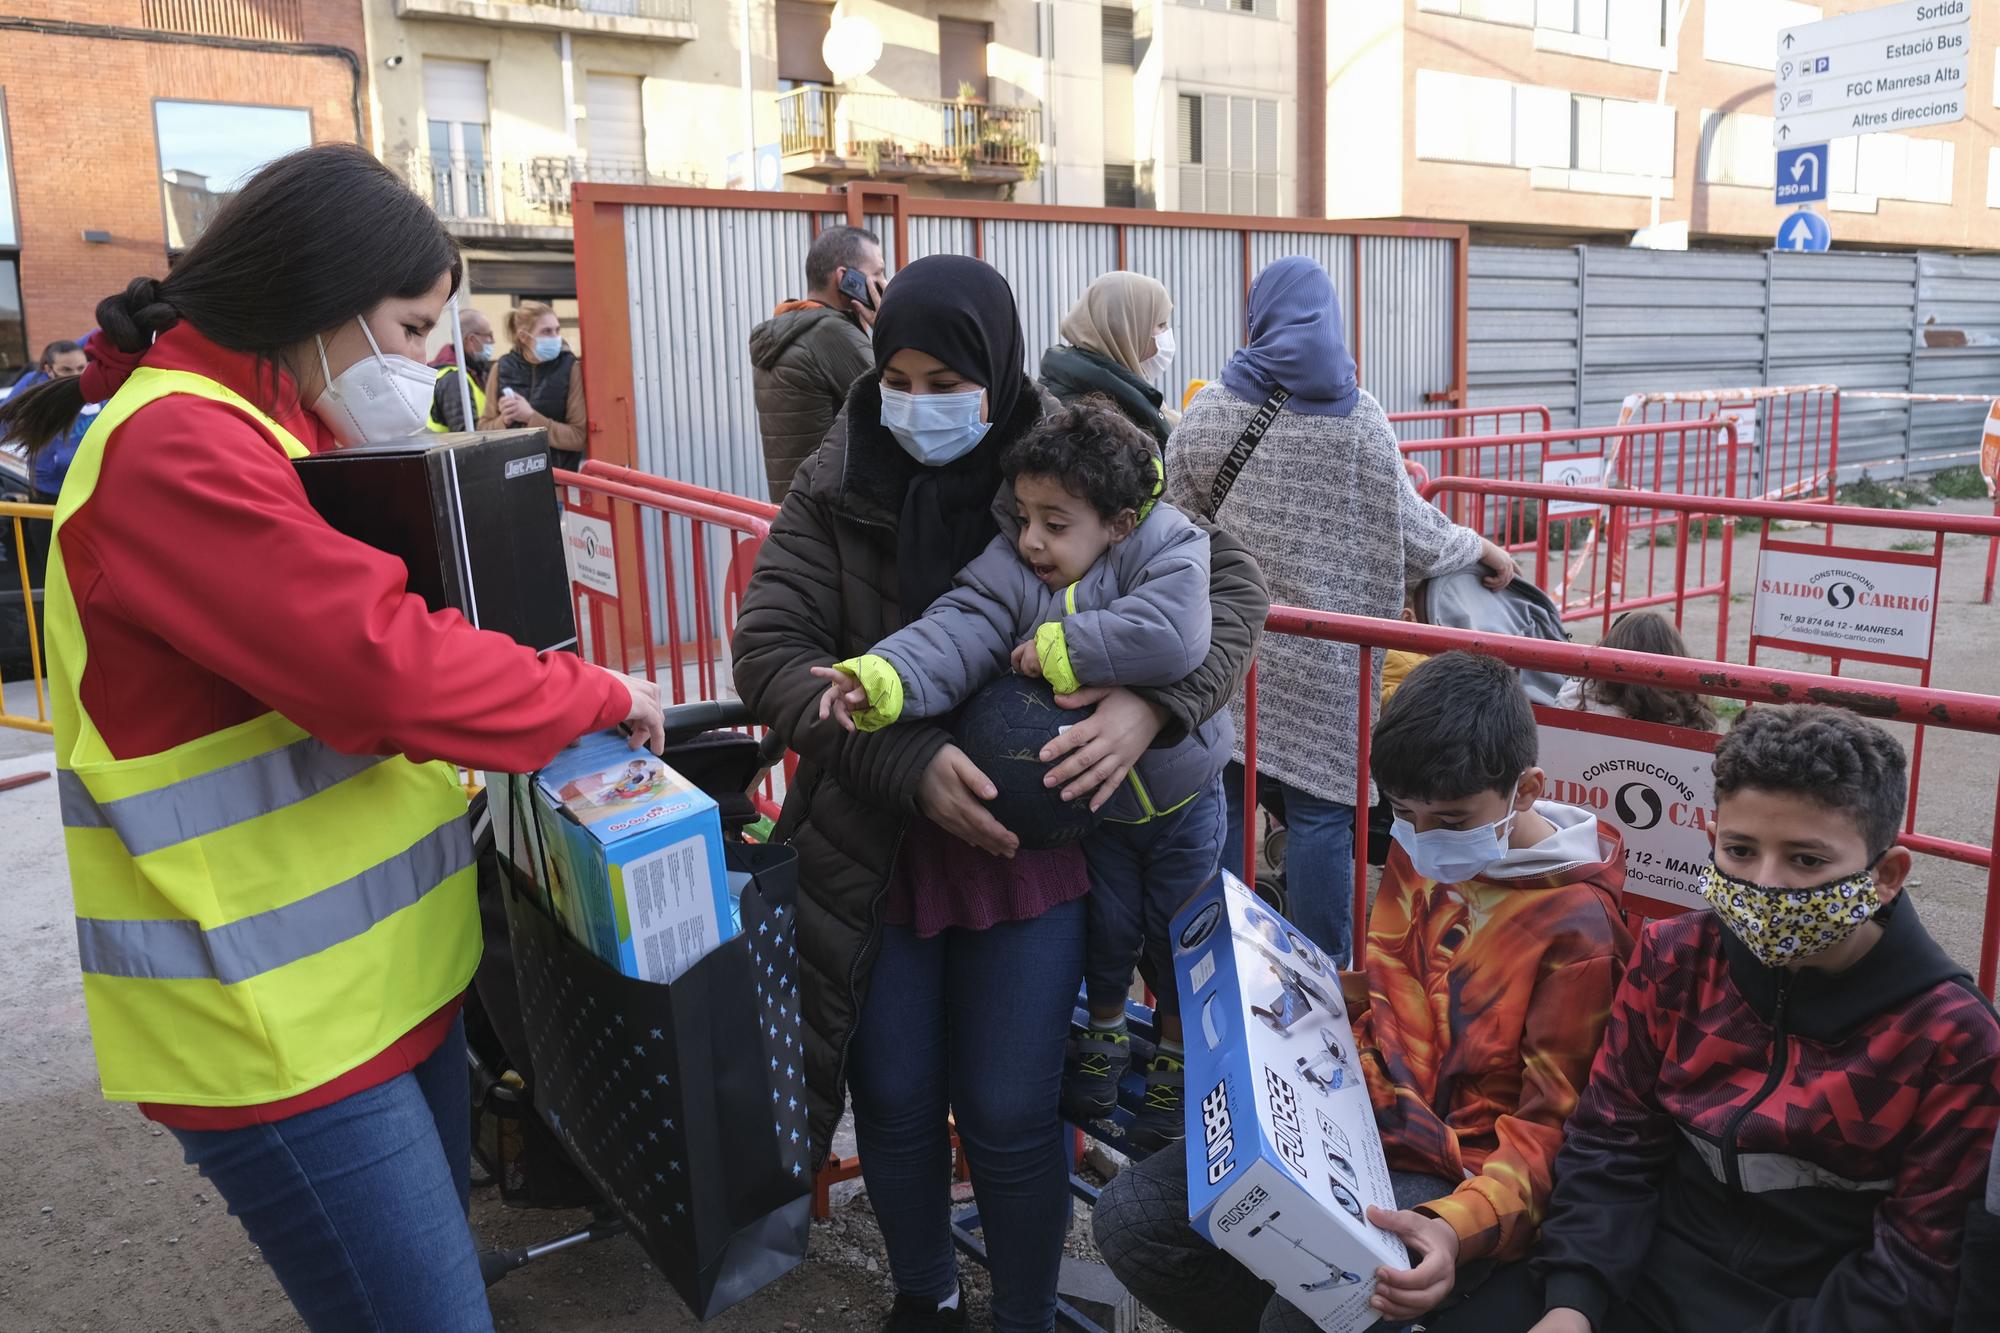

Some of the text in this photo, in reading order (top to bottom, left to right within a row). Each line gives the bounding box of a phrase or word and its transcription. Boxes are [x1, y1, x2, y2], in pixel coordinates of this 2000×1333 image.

[1916, 2, 1964, 21] Sortida
[1886, 35, 1963, 59] Estació Bus
[1846, 67, 1960, 97] FGC Manresa Alta
[1852, 101, 1958, 127] Altres direccions
[1778, 184, 1810, 196] 250 m
[1230, 440, 1253, 466] MY
[506, 458, 544, 476] Jet Ace
[1809, 569, 1875, 591] CONSTRUCCIONS
[1761, 579, 1929, 612] SALIDO CARRIÓ
[1779, 613, 1794, 622] Tel.
[1795, 615, 1806, 624] 93
[1807, 617, 1822, 627] 874
[1824, 620, 1835, 630] 64
[1837, 622, 1848, 632] 12
[1854, 623, 1904, 637] MANRESA
[1792, 626, 1886, 645] salido@salido-carrio.com
[1582, 760, 1695, 802] CONSTRUCCIONS
[1669, 802, 1717, 831] CA
[1635, 851, 1652, 865] 12
[1665, 858, 1704, 877] MAN
[1201, 1078, 1236, 1186] FUNBEE
[1265, 1065, 1308, 1178] FUNBEE
[1218, 1185, 1268, 1232] FUNBEE
